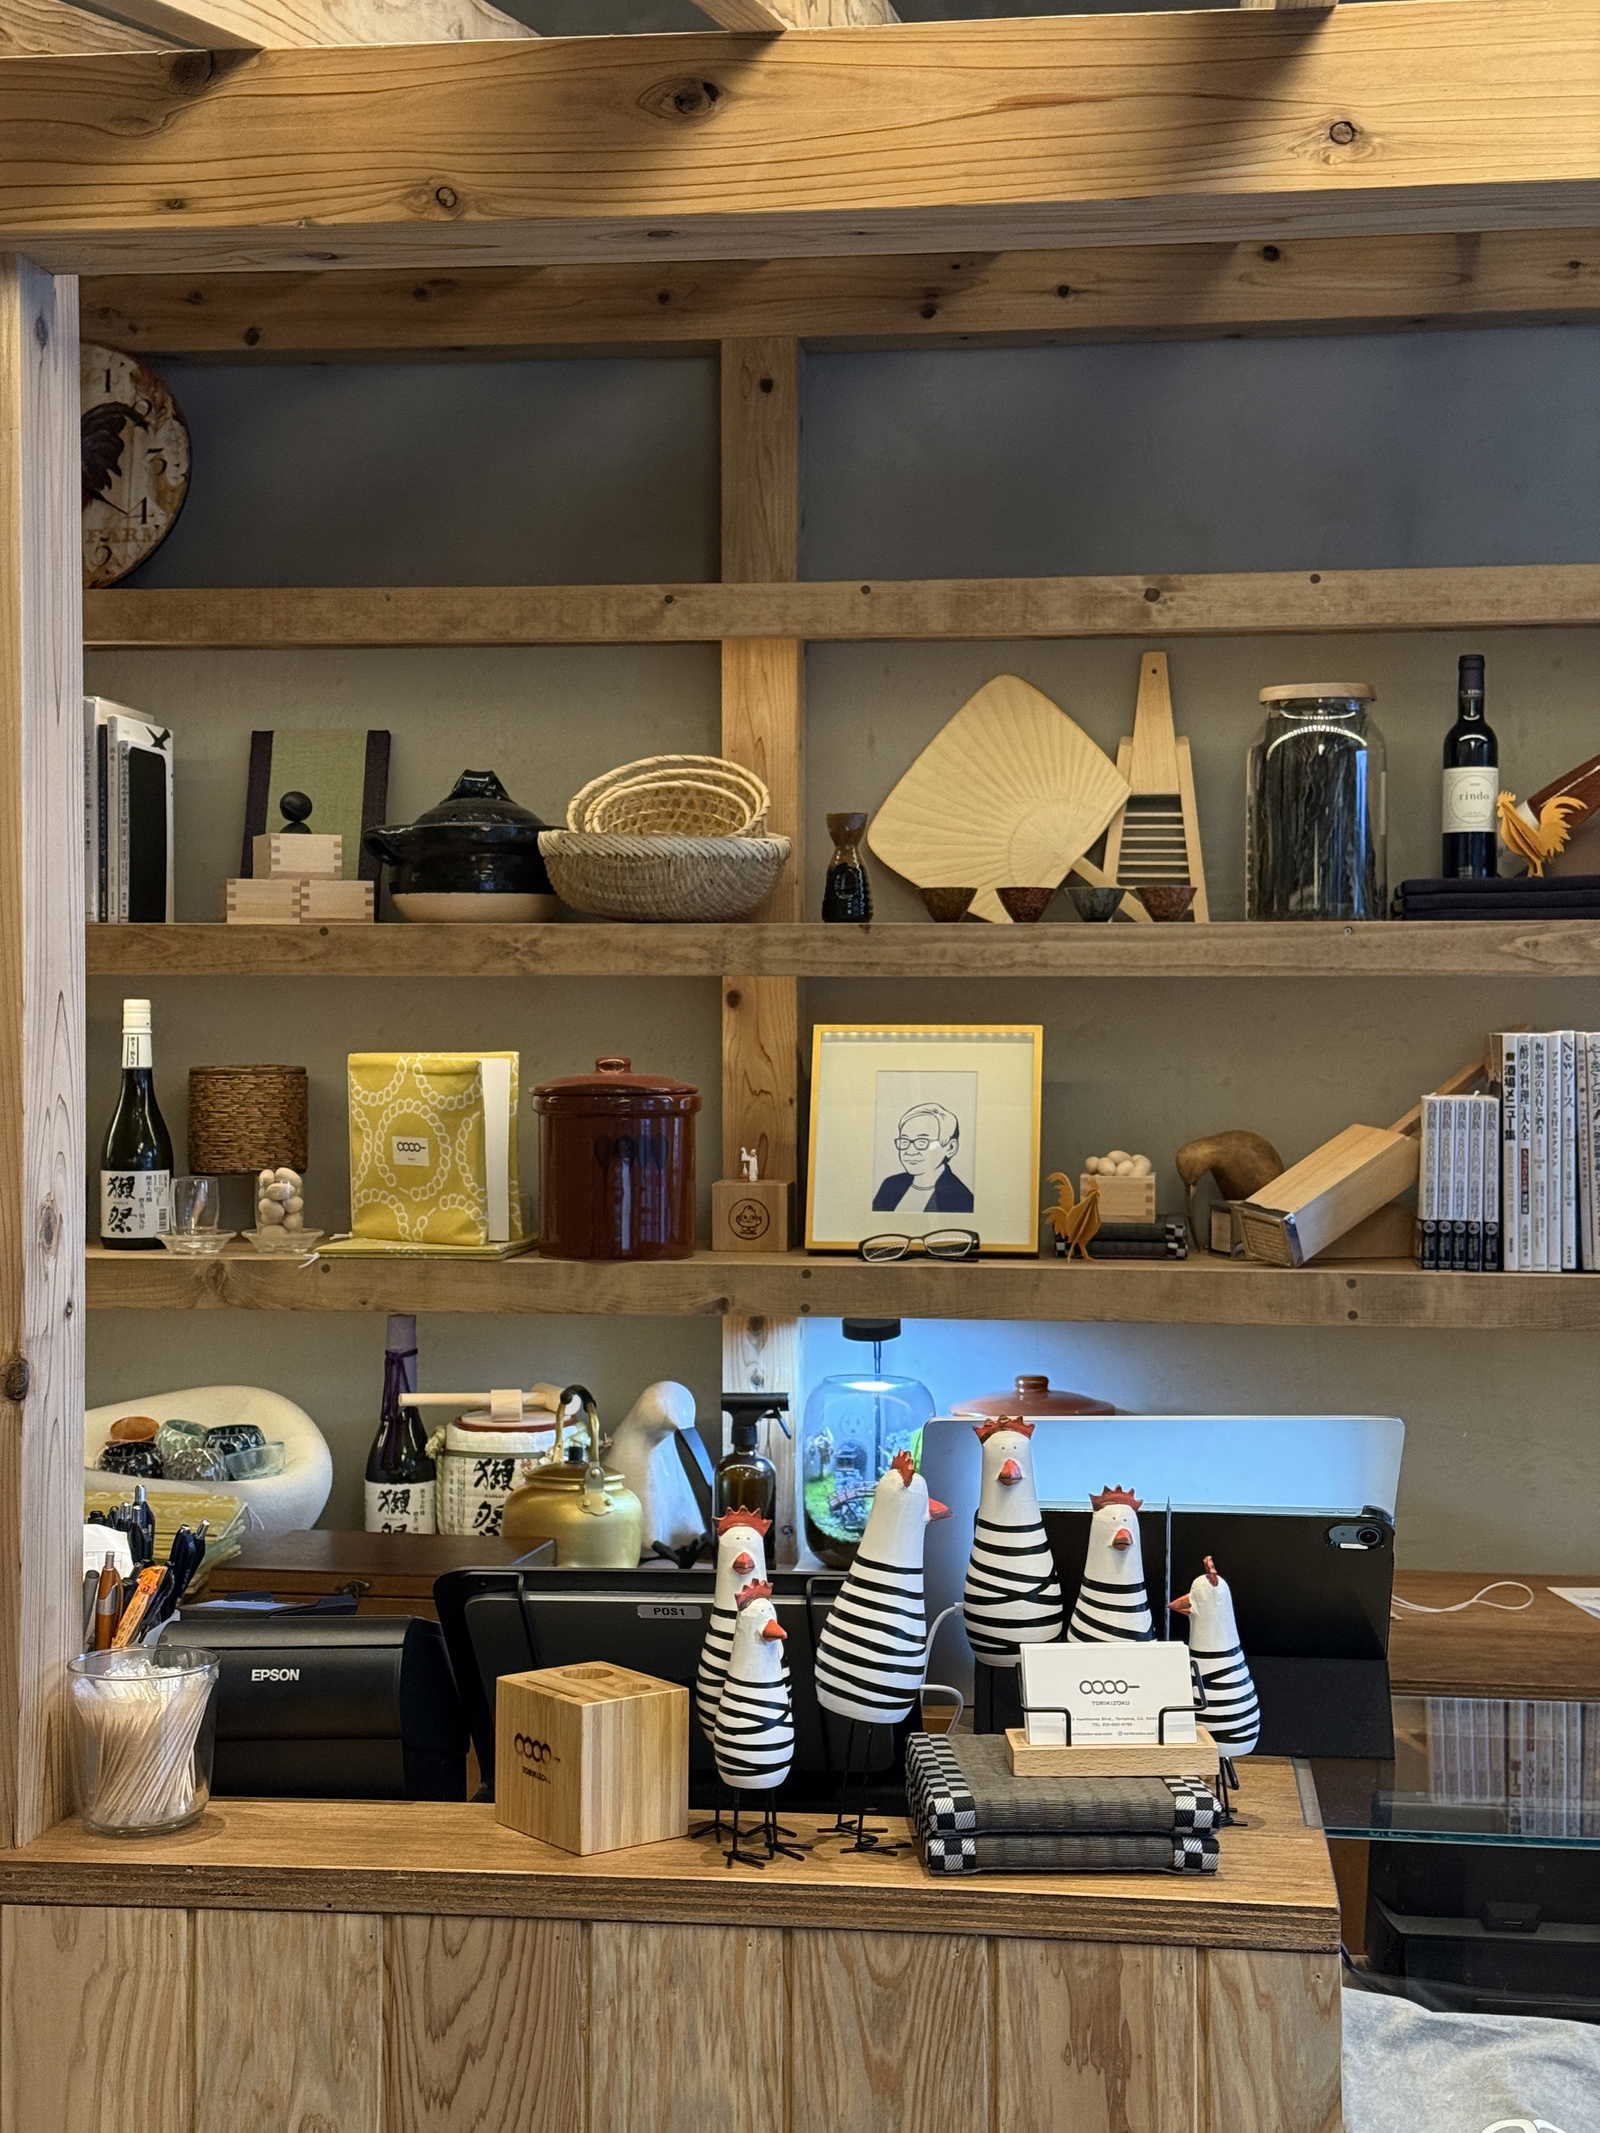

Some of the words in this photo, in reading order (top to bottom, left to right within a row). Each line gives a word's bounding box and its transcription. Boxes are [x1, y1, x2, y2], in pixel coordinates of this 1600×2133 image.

[1459, 791, 1490, 801] rindo
[653, 1607, 686, 1616] POS1
[251, 1668, 300, 1681] EPSON
